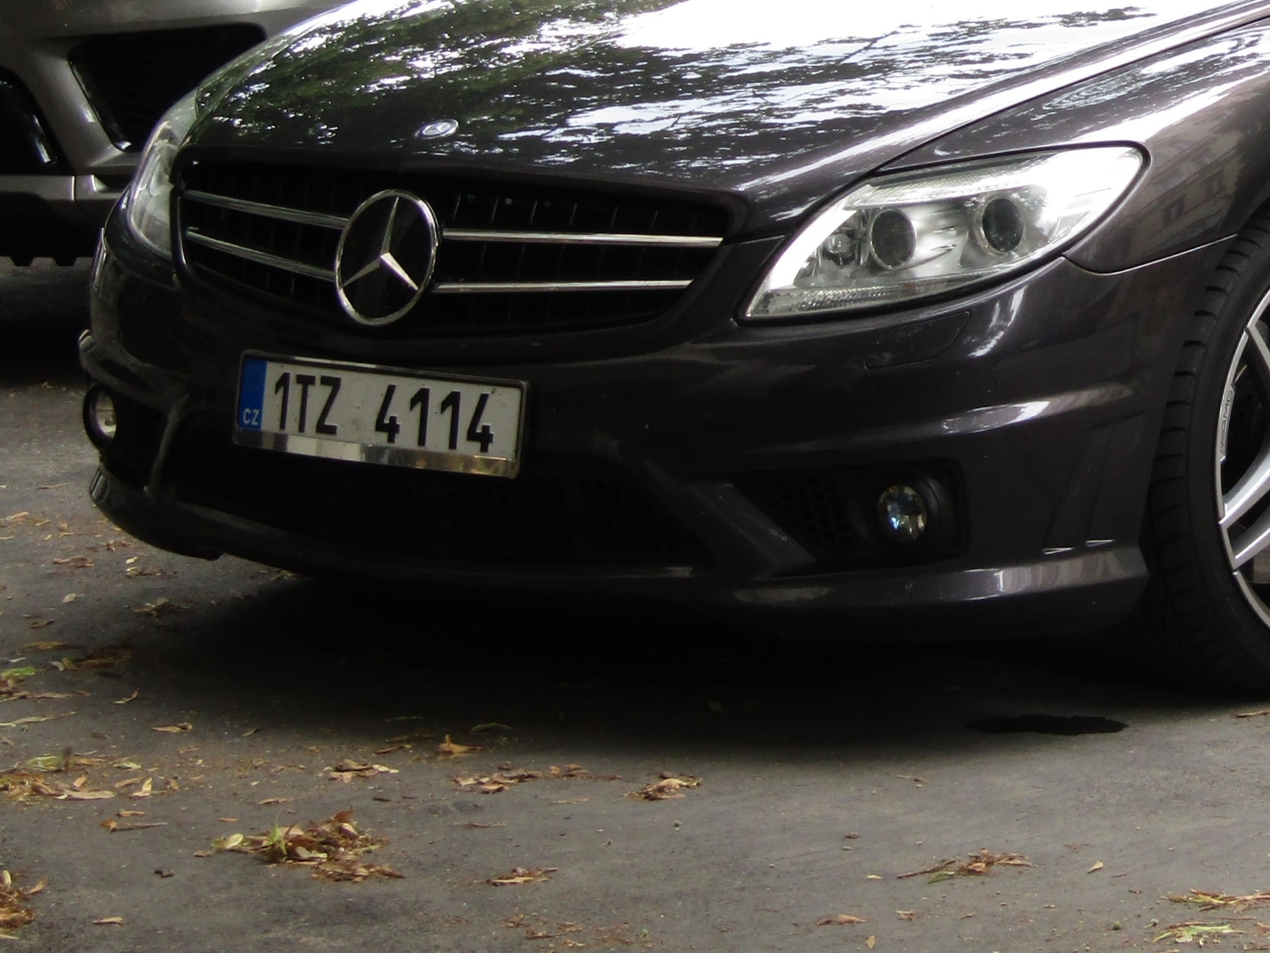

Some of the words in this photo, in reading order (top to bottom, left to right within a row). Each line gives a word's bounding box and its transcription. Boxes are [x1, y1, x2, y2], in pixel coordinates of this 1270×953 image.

[243, 408, 259, 426] CZ
[275, 372, 341, 435] 1TZ
[375, 384, 494, 453] 4114
